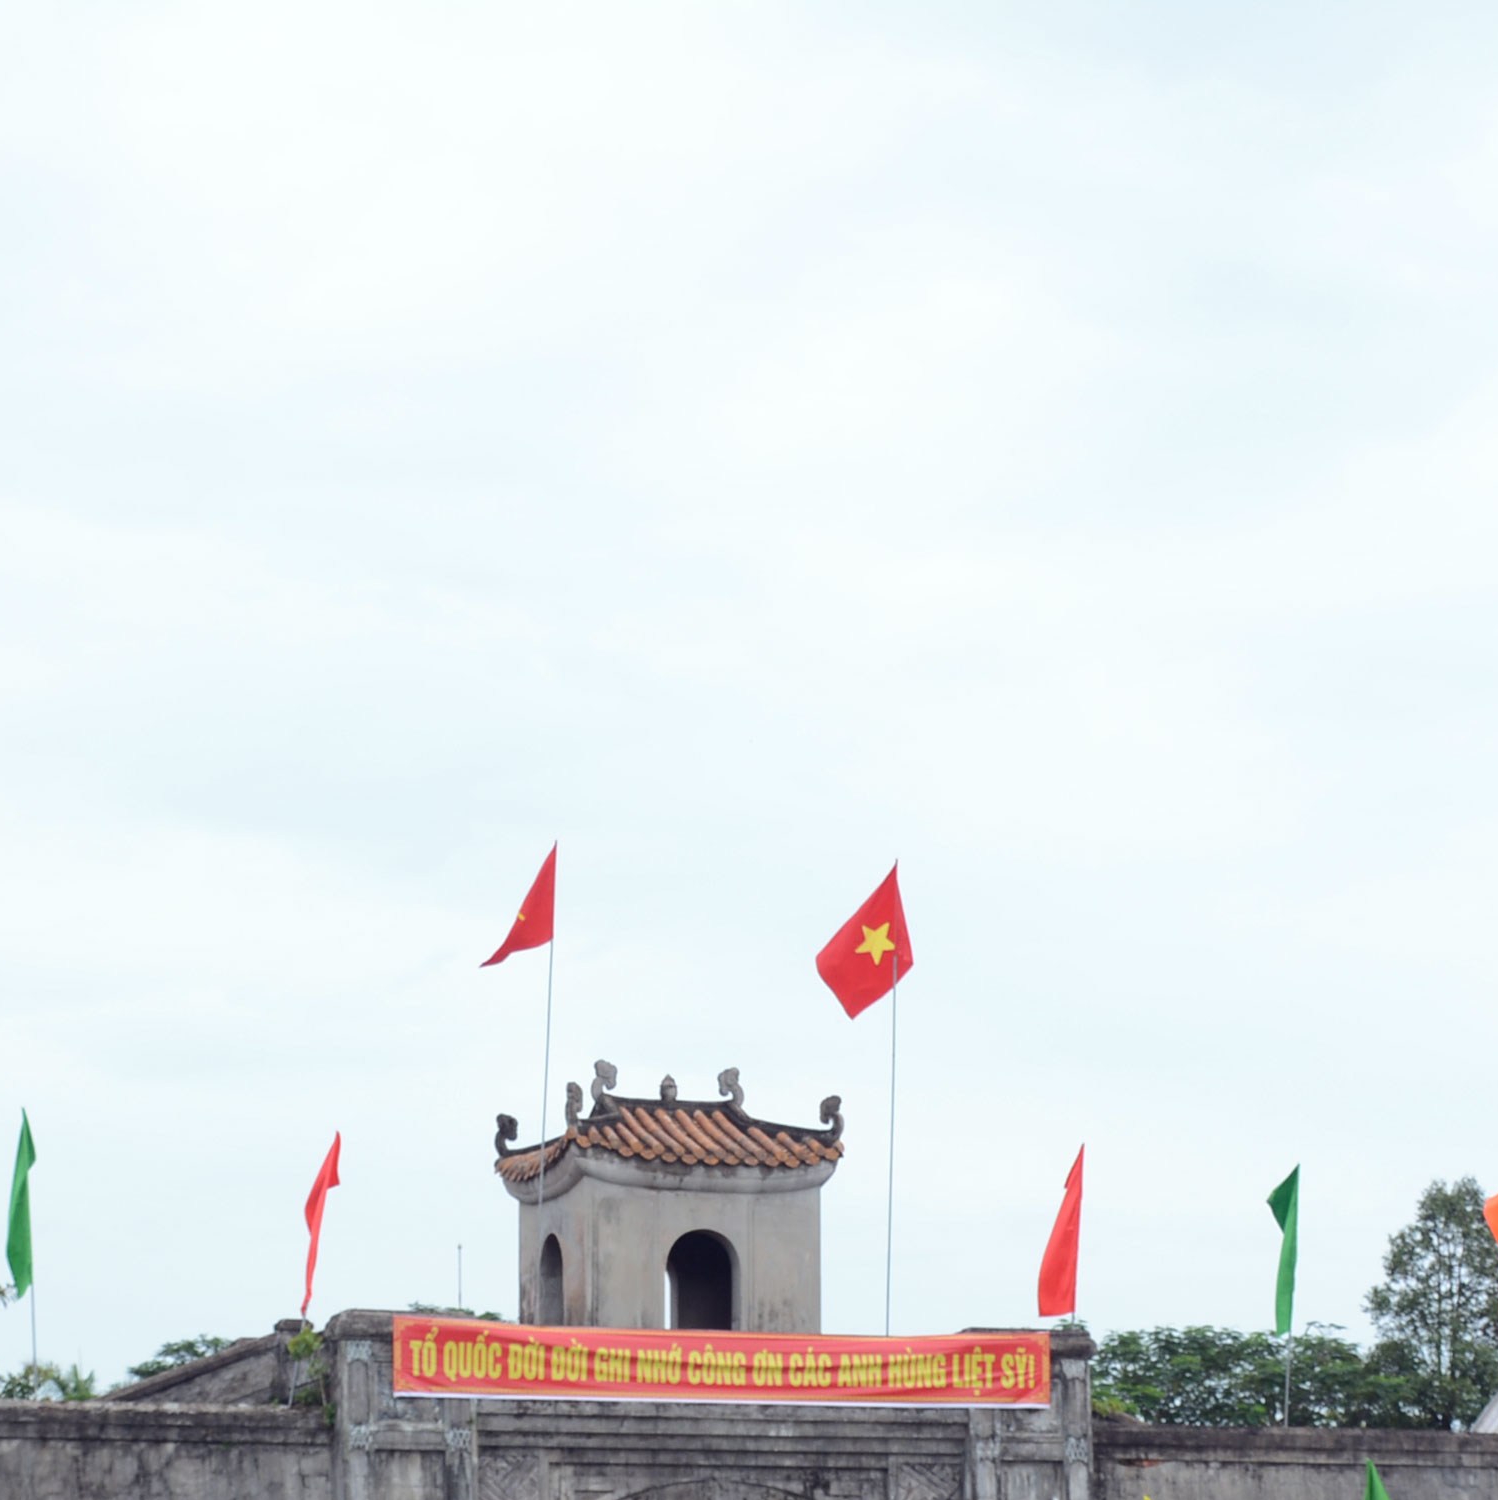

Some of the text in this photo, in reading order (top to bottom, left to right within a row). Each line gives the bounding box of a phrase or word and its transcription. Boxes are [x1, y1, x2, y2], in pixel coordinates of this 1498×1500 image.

[409, 1327, 1035, 1396] TỔ QUỐC ĐỜI ĐỜI GHI NHỚ CÔNG ƠN CÁC ANH HÙNG LIỆT SỸ!
